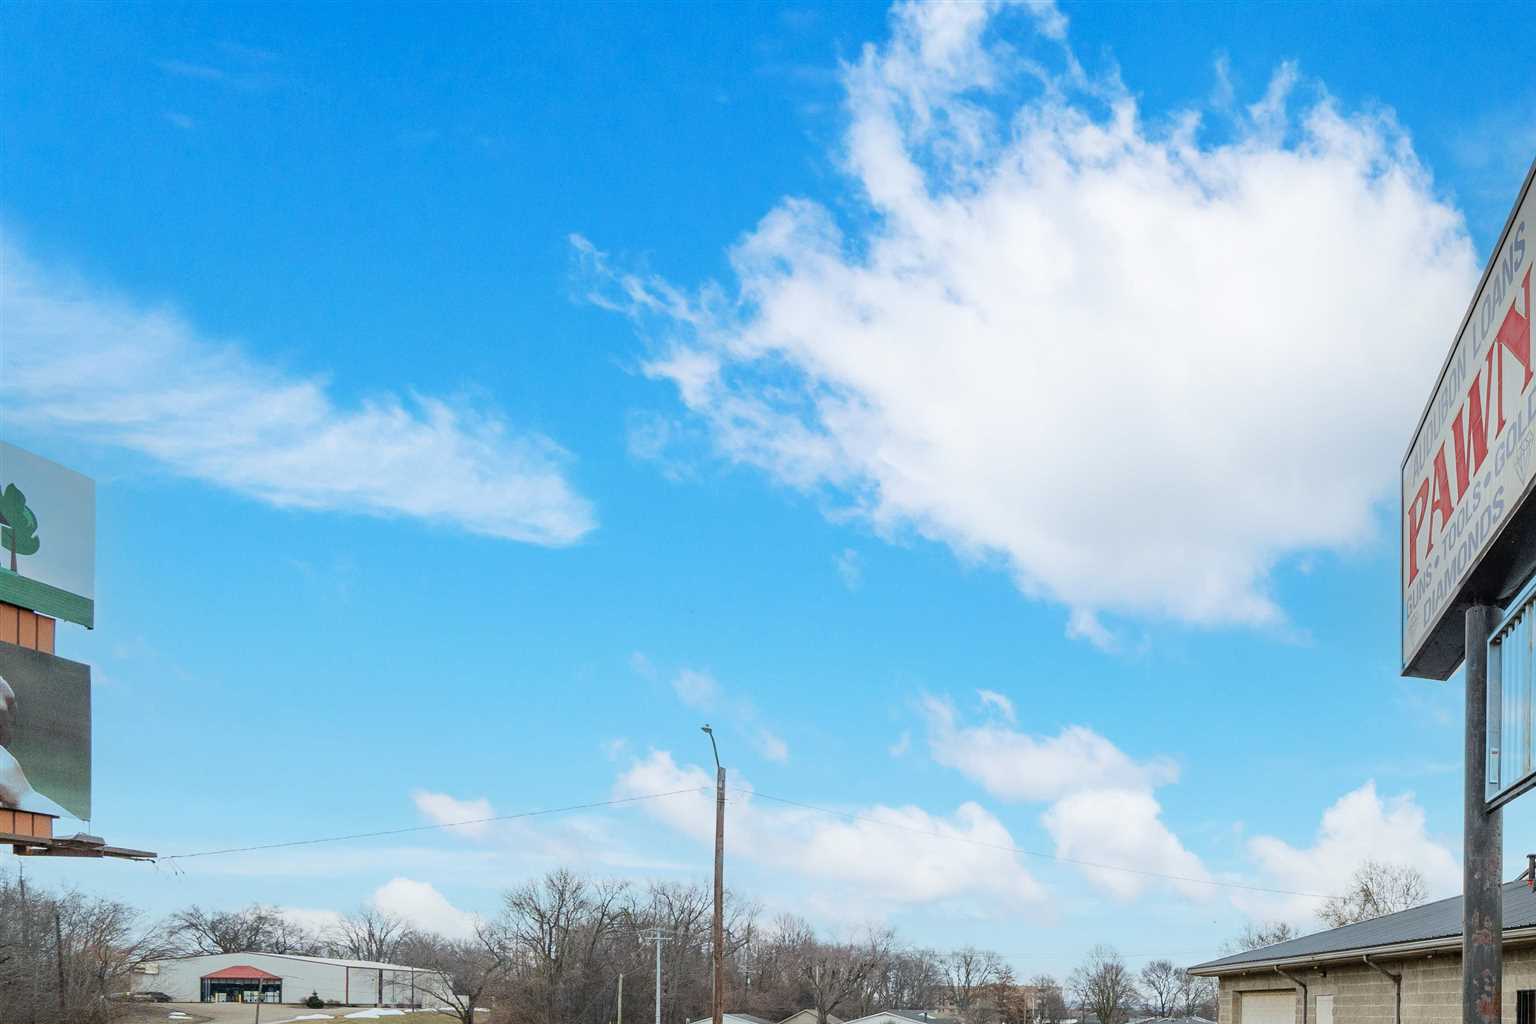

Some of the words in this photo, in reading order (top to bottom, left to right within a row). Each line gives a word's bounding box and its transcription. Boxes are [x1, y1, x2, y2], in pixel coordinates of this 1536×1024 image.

[1408, 261, 1534, 588] PAWN
[1410, 348, 1467, 483] AUDUBON
[1472, 220, 1525, 360] LOANS
[1407, 560, 1432, 619] GUNS
[1442, 482, 1481, 551] TOOLS
[1423, 486, 1505, 624] DIAMONDS
